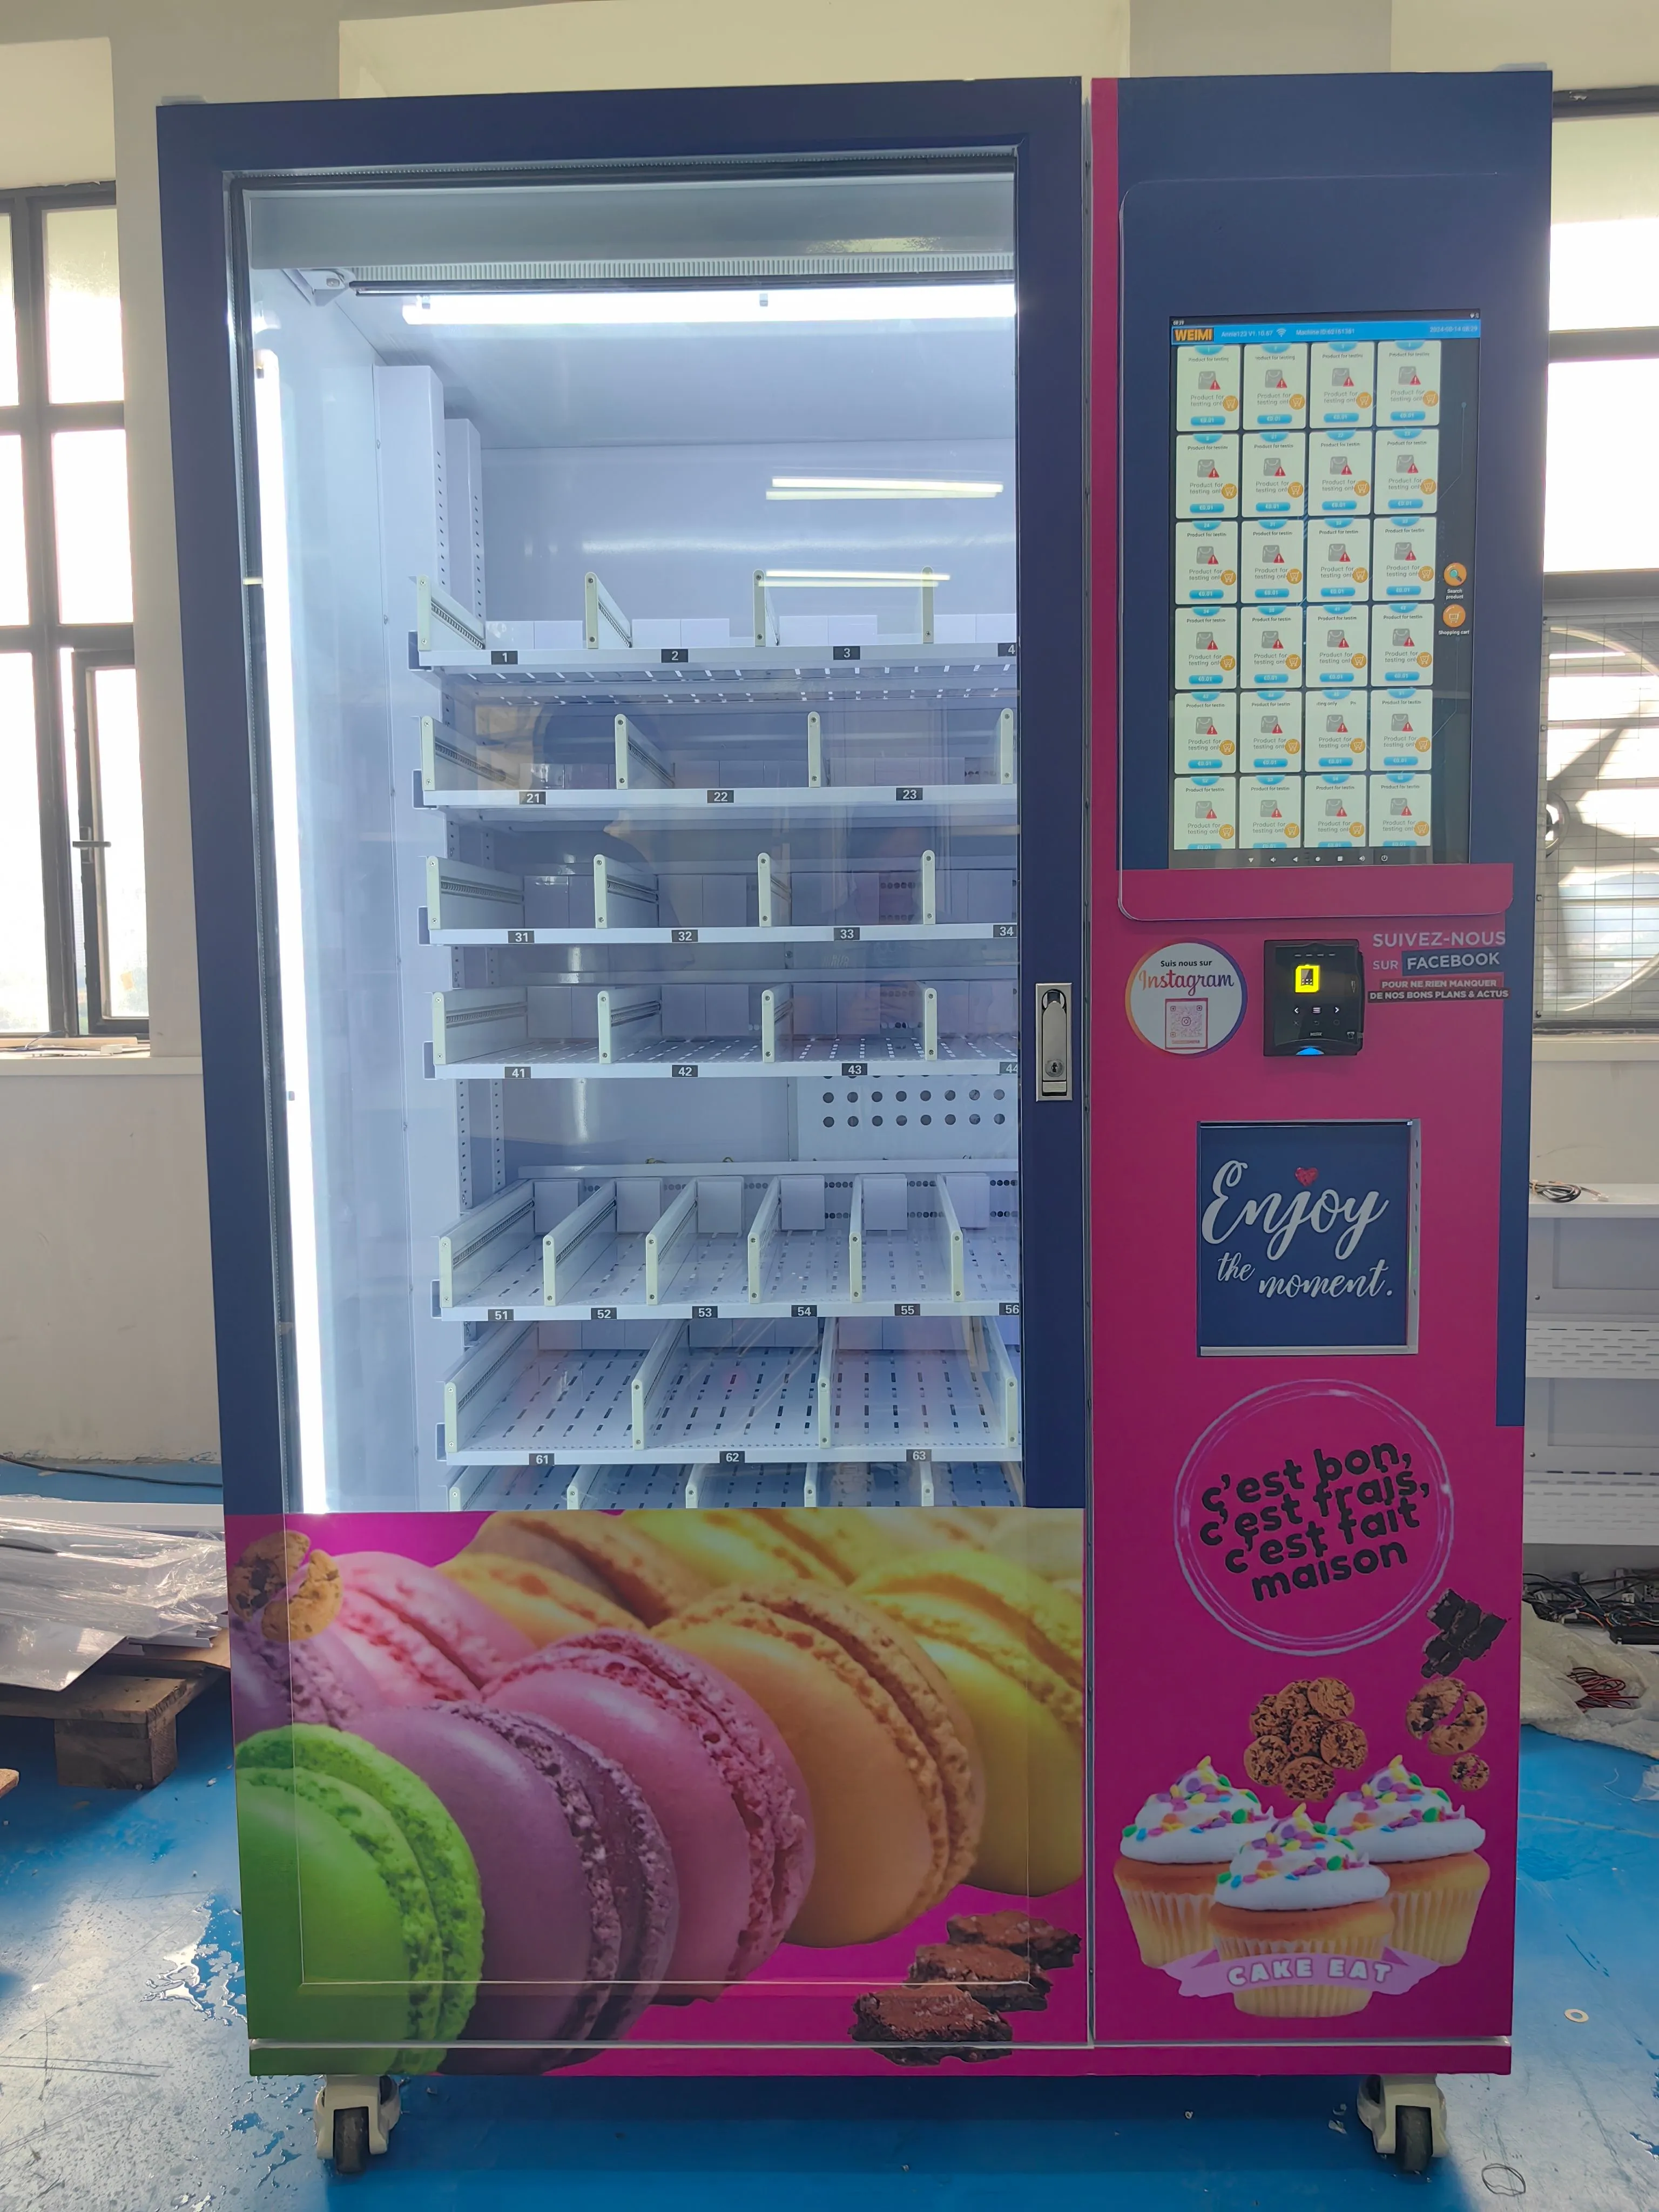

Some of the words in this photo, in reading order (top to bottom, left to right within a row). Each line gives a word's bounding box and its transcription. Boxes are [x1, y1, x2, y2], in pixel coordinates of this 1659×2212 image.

[1175, 328, 1212, 341] WEIMI
[843, 649, 851, 658] 3
[1008, 644, 1015, 654] 4
[502, 652, 508, 663] 1
[672, 651, 679, 660] 2
[526, 793, 541, 803] 21
[714, 792, 728, 801] 22
[902, 790, 917, 800] 23
[840, 929, 854, 939] 33
[999, 926, 1014, 936] 34
[515, 933, 529, 942] 31
[678, 932, 692, 941] 32
[1373, 931, 1506, 947] SUIVEZ-NOUS
[1373, 960, 1398, 970] SUR
[1407, 952, 1500, 969] FACEBOOK
[1139, 969, 1234, 996] Instagram
[511, 1069, 525, 1078] 41
[678, 1067, 692, 1076] 42
[848, 1065, 862, 1075] 43
[1006, 1064, 1018, 1073] 44
[1202, 1159, 1389, 1260] Enjoy
[1218, 1252, 1255, 1282] the
[1259, 1259, 1392, 1298] moment.
[597, 1310, 611, 1319] 52
[698, 1307, 712, 1317] 53
[797, 1306, 811, 1316] 54
[901, 1305, 915, 1315] 55
[1006, 1305, 1019, 1314] 56
[495, 1311, 508, 1320] 51
[536, 1455, 548, 1464] 61
[726, 1453, 739, 1462] 62
[913, 1451, 926, 1460] 63
[1202, 1459, 1305, 1511] c'est
[1313, 1442, 1411, 1481] bon,
[1200, 1494, 1303, 1545] c'est
[1313, 1471, 1429, 1517] frais,
[1225, 1521, 1328, 1573] c'est
[1338, 1498, 1419, 1544] fait
[1252, 1542, 1407, 1601] maison
[1228, 1959, 1312, 1985] CAKE
[1328, 1958, 1392, 1982] EAT
